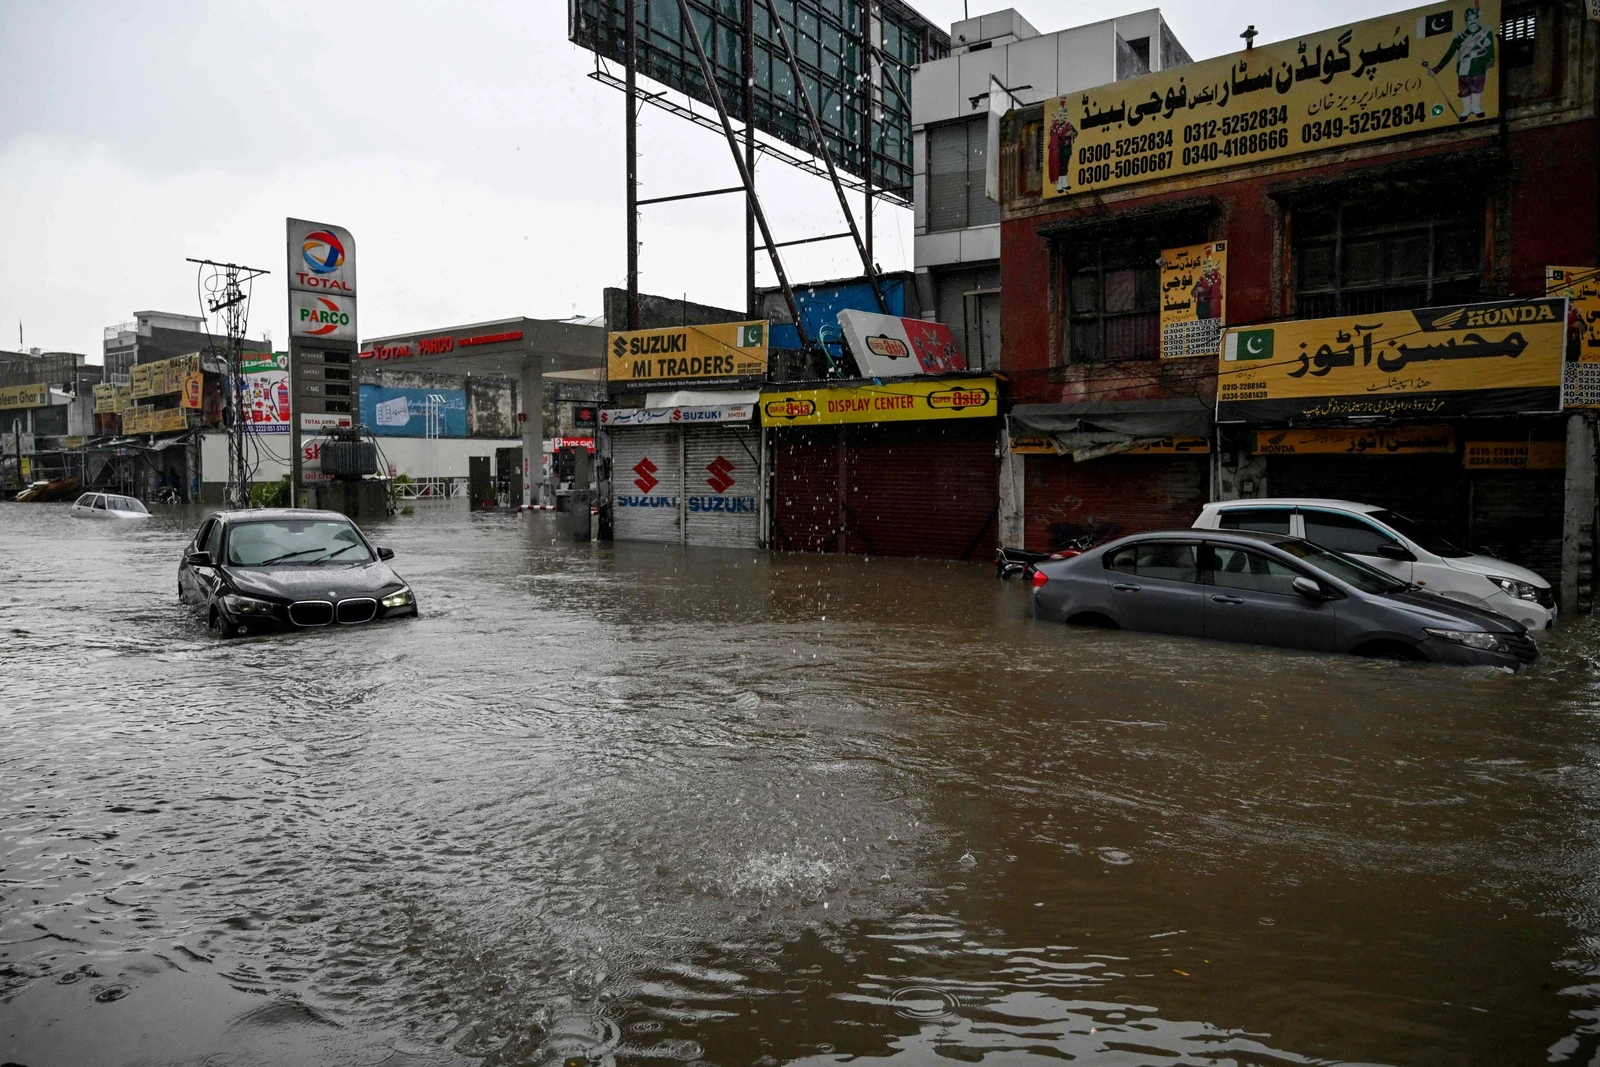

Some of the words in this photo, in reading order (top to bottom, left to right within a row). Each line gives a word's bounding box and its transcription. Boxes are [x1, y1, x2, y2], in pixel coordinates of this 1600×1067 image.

[1276, 30, 1353, 95] گولڈن
[1217, 60, 1273, 107] سٹار
[1128, 77, 1187, 127] فوجی
[1308, 93, 1335, 116] خان
[1080, 94, 1126, 133] بینڈ
[1302, 102, 1426, 144] 0349-5252834
[1184, 105, 1288, 144] 0312-5252834
[1079, 129, 1174, 165] 0300-5252834
[1182, 128, 1289, 166] 0340-4188666
[1078, 151, 1174, 186] 0300-5060687
[295, 272, 352, 292] TOTAL
[1163, 271, 1193, 292] فوجی
[1164, 293, 1191, 313] بینڈ
[300, 308, 350, 326] PARCO
[1466, 304, 1555, 327] HONDA
[374, 345, 413, 359] TOTAL
[418, 336, 454, 355] PARCO
[630, 334, 687, 355] SUZUKI
[1287, 323, 1384, 378] آٹوز
[1377, 331, 1529, 372] محسن
[632, 360, 652, 378] MI
[657, 355, 734, 376] TRADERS
[20, 390, 37, 404] Ghar
[307, 385, 319, 393] CNG
[1222, 382, 1267, 391] 0315-2288143
[1222, 391, 1268, 400] 0334-5581439
[769, 405, 785, 414] SUPER
[786, 401, 810, 415] asia
[828, 396, 870, 413] DISPLAY
[874, 394, 914, 410] CENTER
[931, 395, 951, 405] SUPER
[952, 390, 983, 406] asia
[683, 411, 722, 420] SUZUKI
[1260, 445, 1296, 453] HONDA
[305, 471, 317, 480] oil
[617, 495, 677, 507] SUZUKI
[688, 495, 755, 513] SUZUKI
